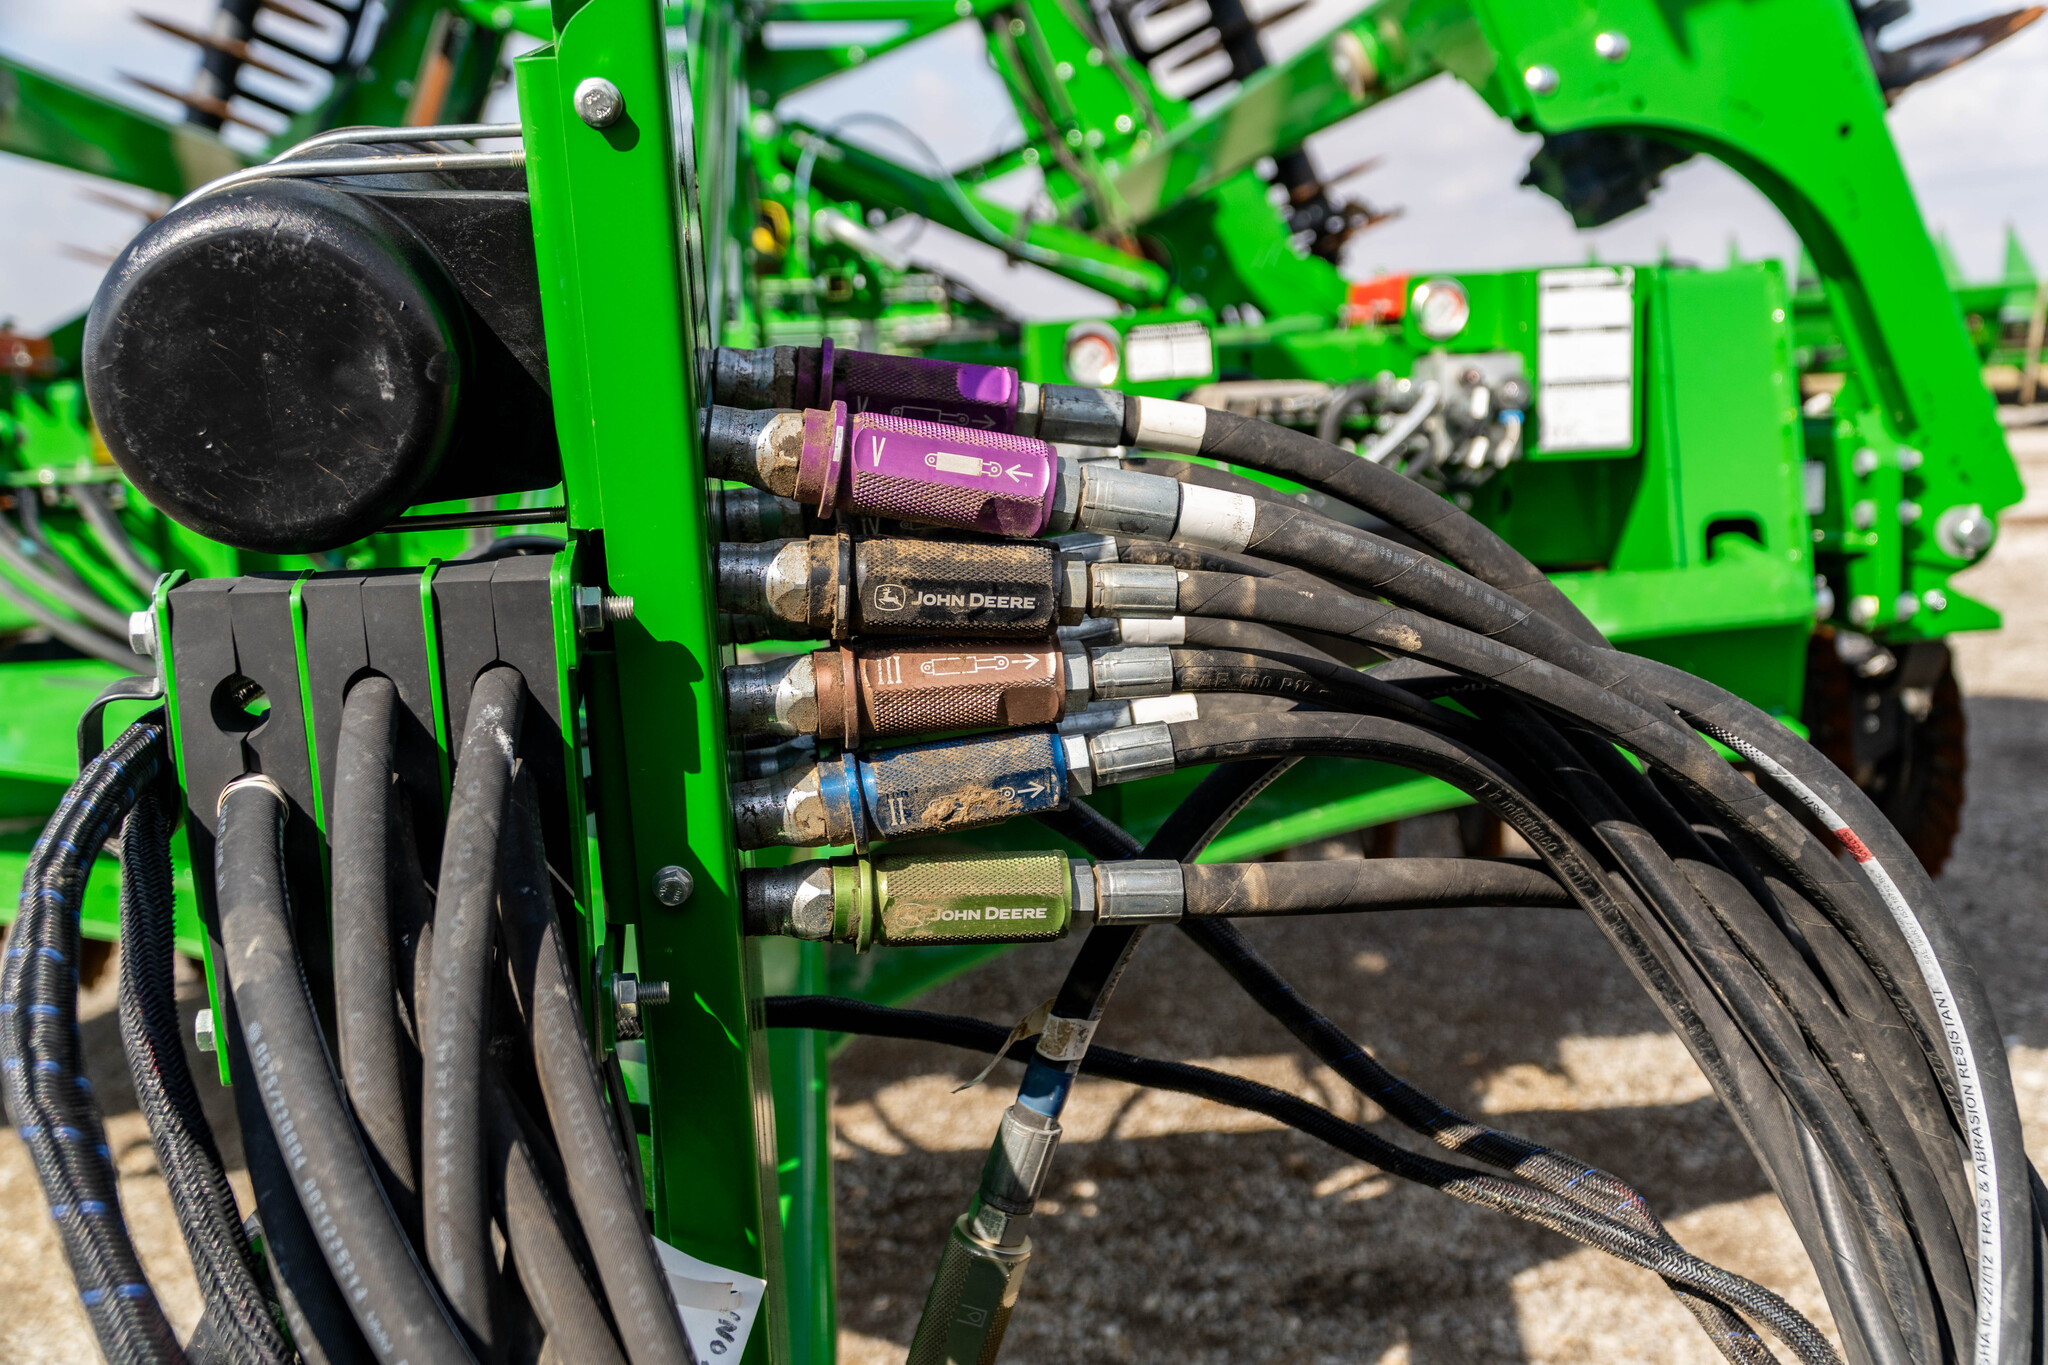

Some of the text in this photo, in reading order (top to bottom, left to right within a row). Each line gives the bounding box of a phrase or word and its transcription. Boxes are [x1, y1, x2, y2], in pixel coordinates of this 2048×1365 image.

[872, 435, 886, 467] V
[911, 591, 1036, 609] JOHN DEERE
[876, 655, 903, 685] III
[1843, 831, 1869, 859] CYCLES
[934, 906, 1048, 921] JOHN DEERE
[1933, 990, 1972, 1080] RESISTANT
[1962, 1084, 1991, 1175] ABRASION
[1978, 1180, 1991, 1192] &
[1980, 1199, 1994, 1245] FRAS
